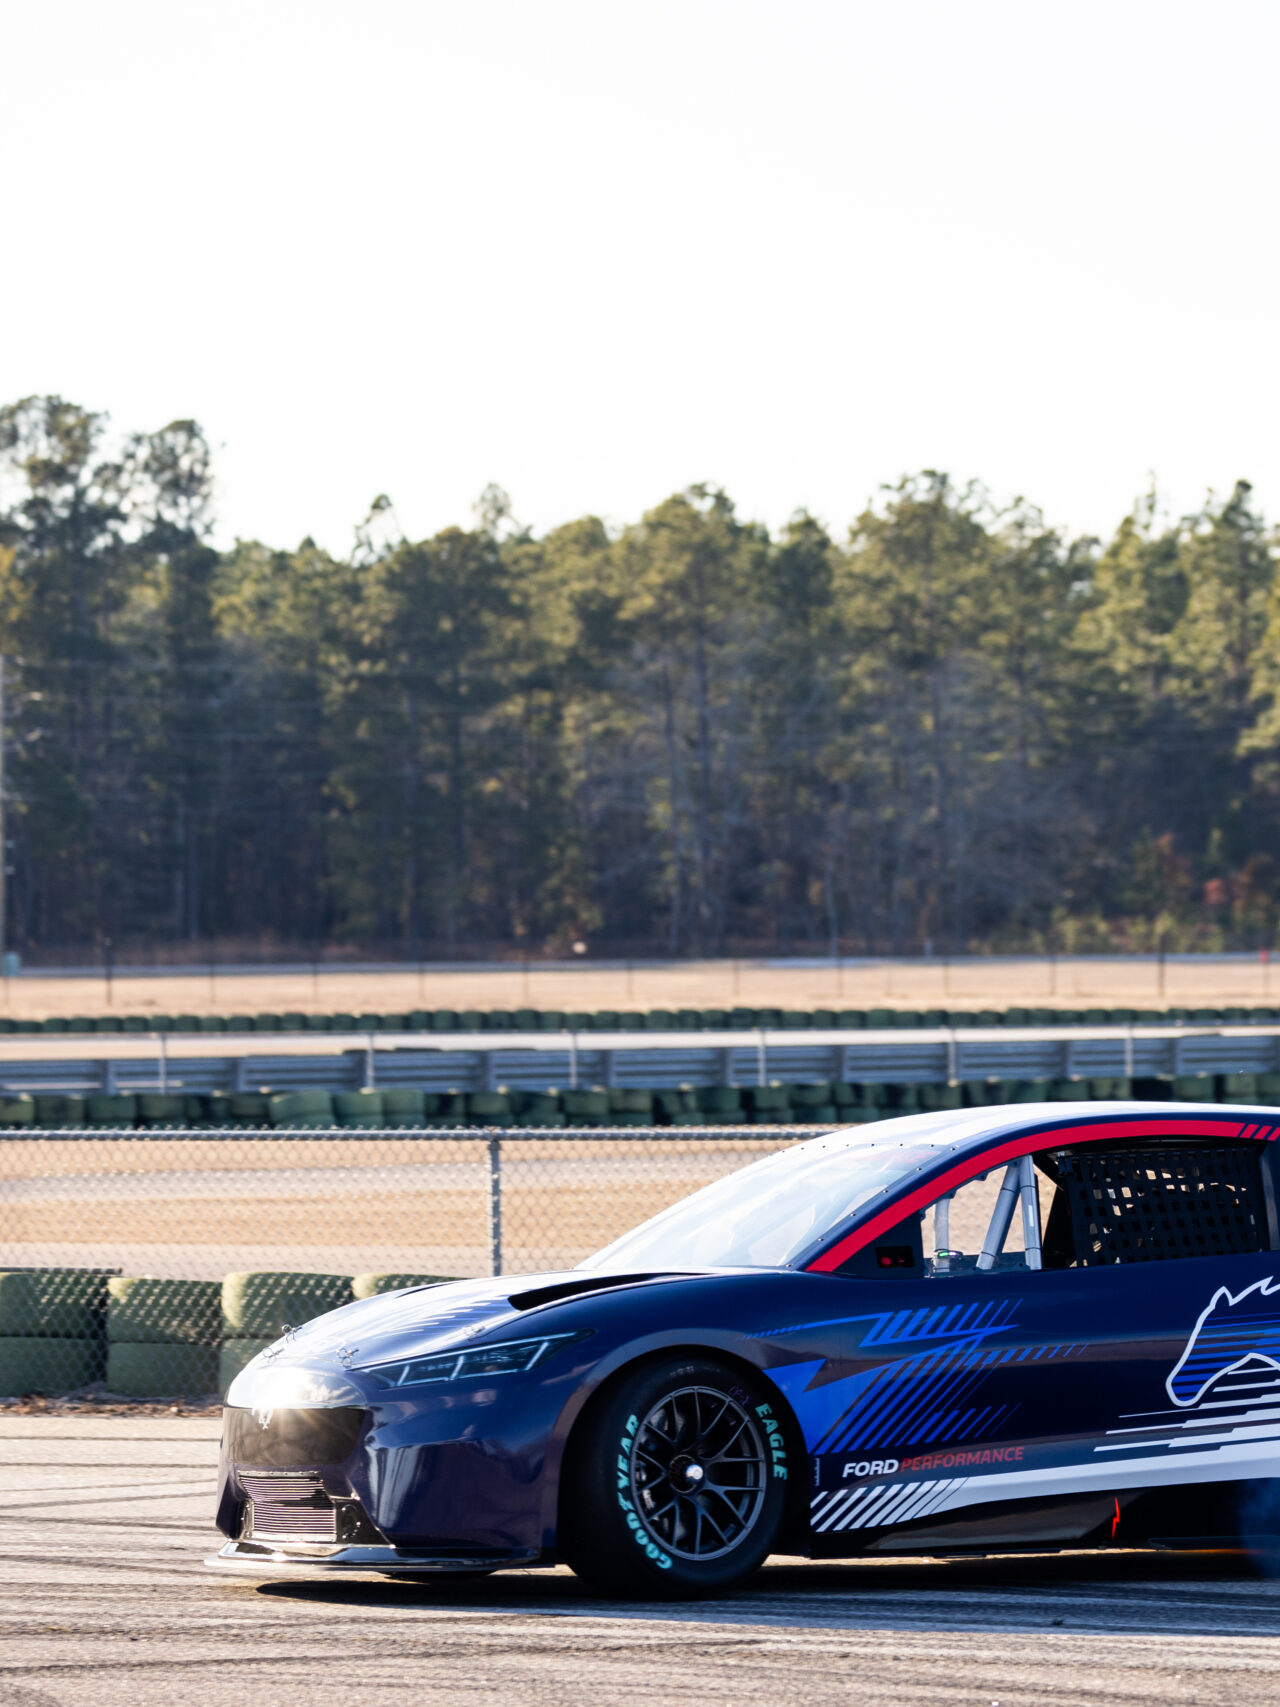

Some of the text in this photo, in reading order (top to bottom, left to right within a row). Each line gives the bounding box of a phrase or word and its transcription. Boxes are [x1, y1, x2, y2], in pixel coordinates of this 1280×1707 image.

[755, 1403, 788, 1480] EAGLE
[842, 1447, 1024, 1477] FORD PERFORMANCE
